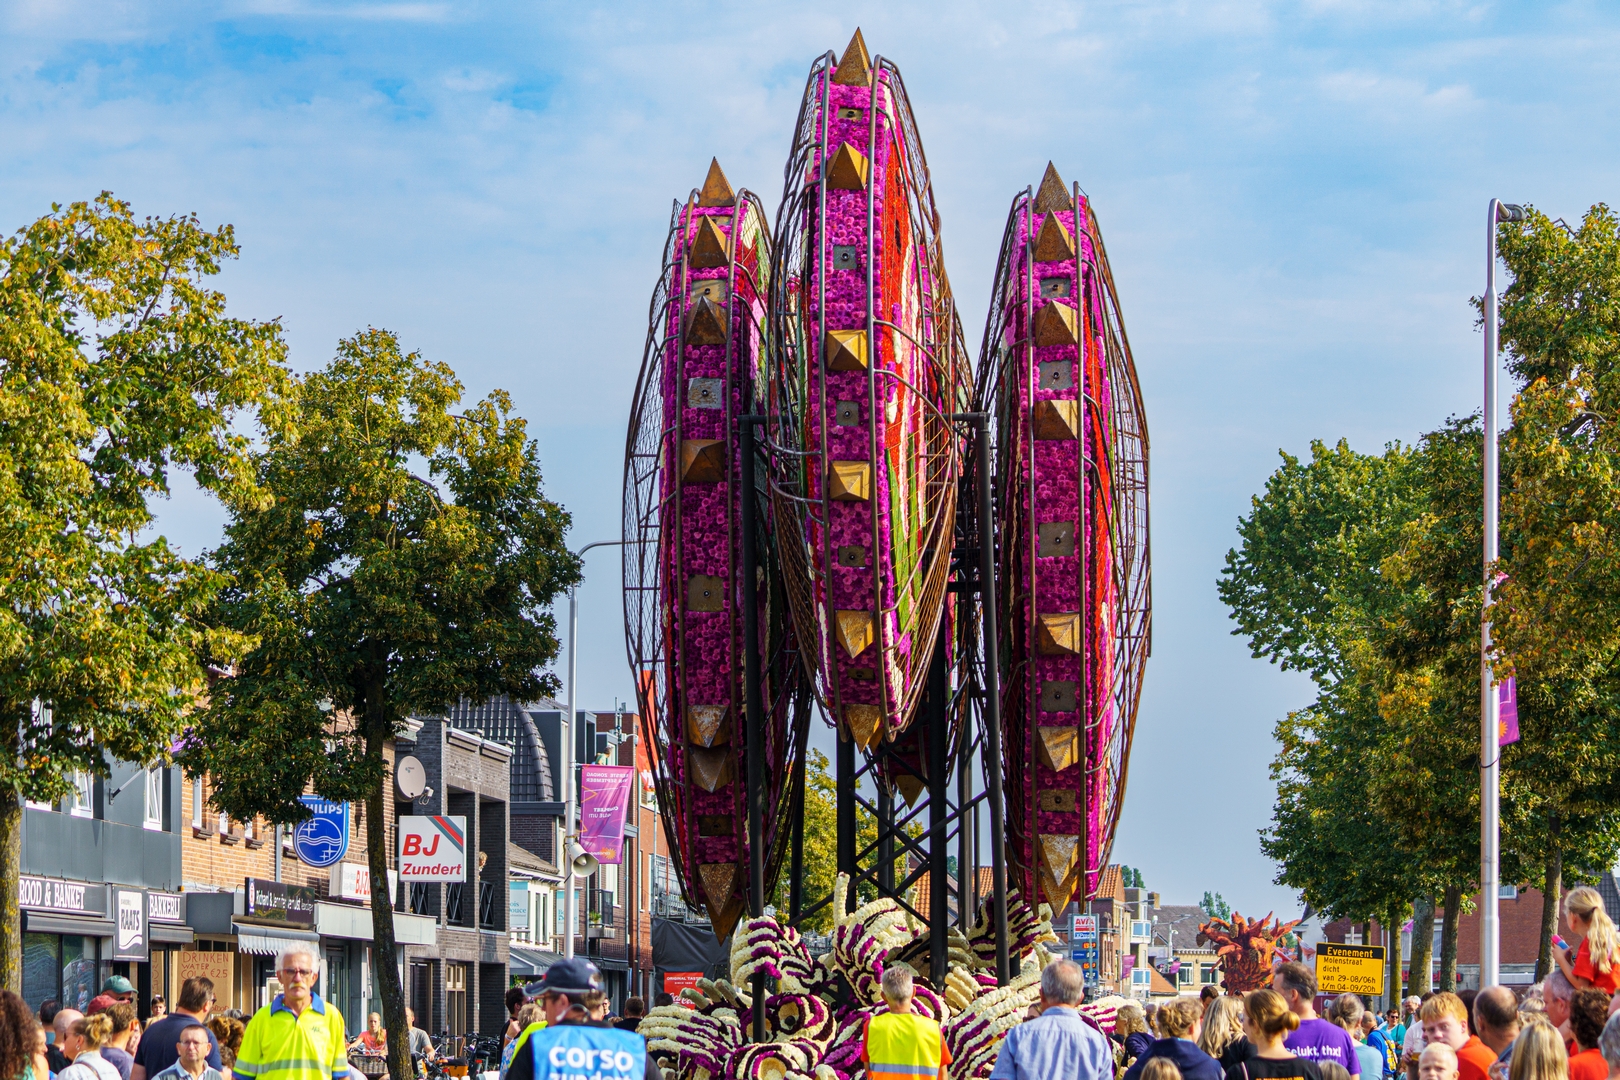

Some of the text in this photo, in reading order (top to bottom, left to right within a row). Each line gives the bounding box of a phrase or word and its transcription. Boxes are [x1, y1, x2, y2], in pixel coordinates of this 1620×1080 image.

[402, 833, 440, 857] BJ
[402, 863, 462, 875] Zundert
[44, 882, 51, 907] &
[54, 883, 85, 910] BANKET
[149, 894, 181, 920] BAKKERIJ
[120, 908, 140, 931] RAATS
[182, 952, 229, 963] DRINKEN
[1327, 946, 1374, 958] Evenement
[1323, 956, 1363, 966] Molenstraat
[1322, 965, 1340, 973] dicht
[1337, 974, 1376, 984] 29-08/06h
[1322, 982, 1376, 993] t/m 04-09/20h
[1321, 1044, 1342, 1057] thx!
[549, 1046, 634, 1072] corso
